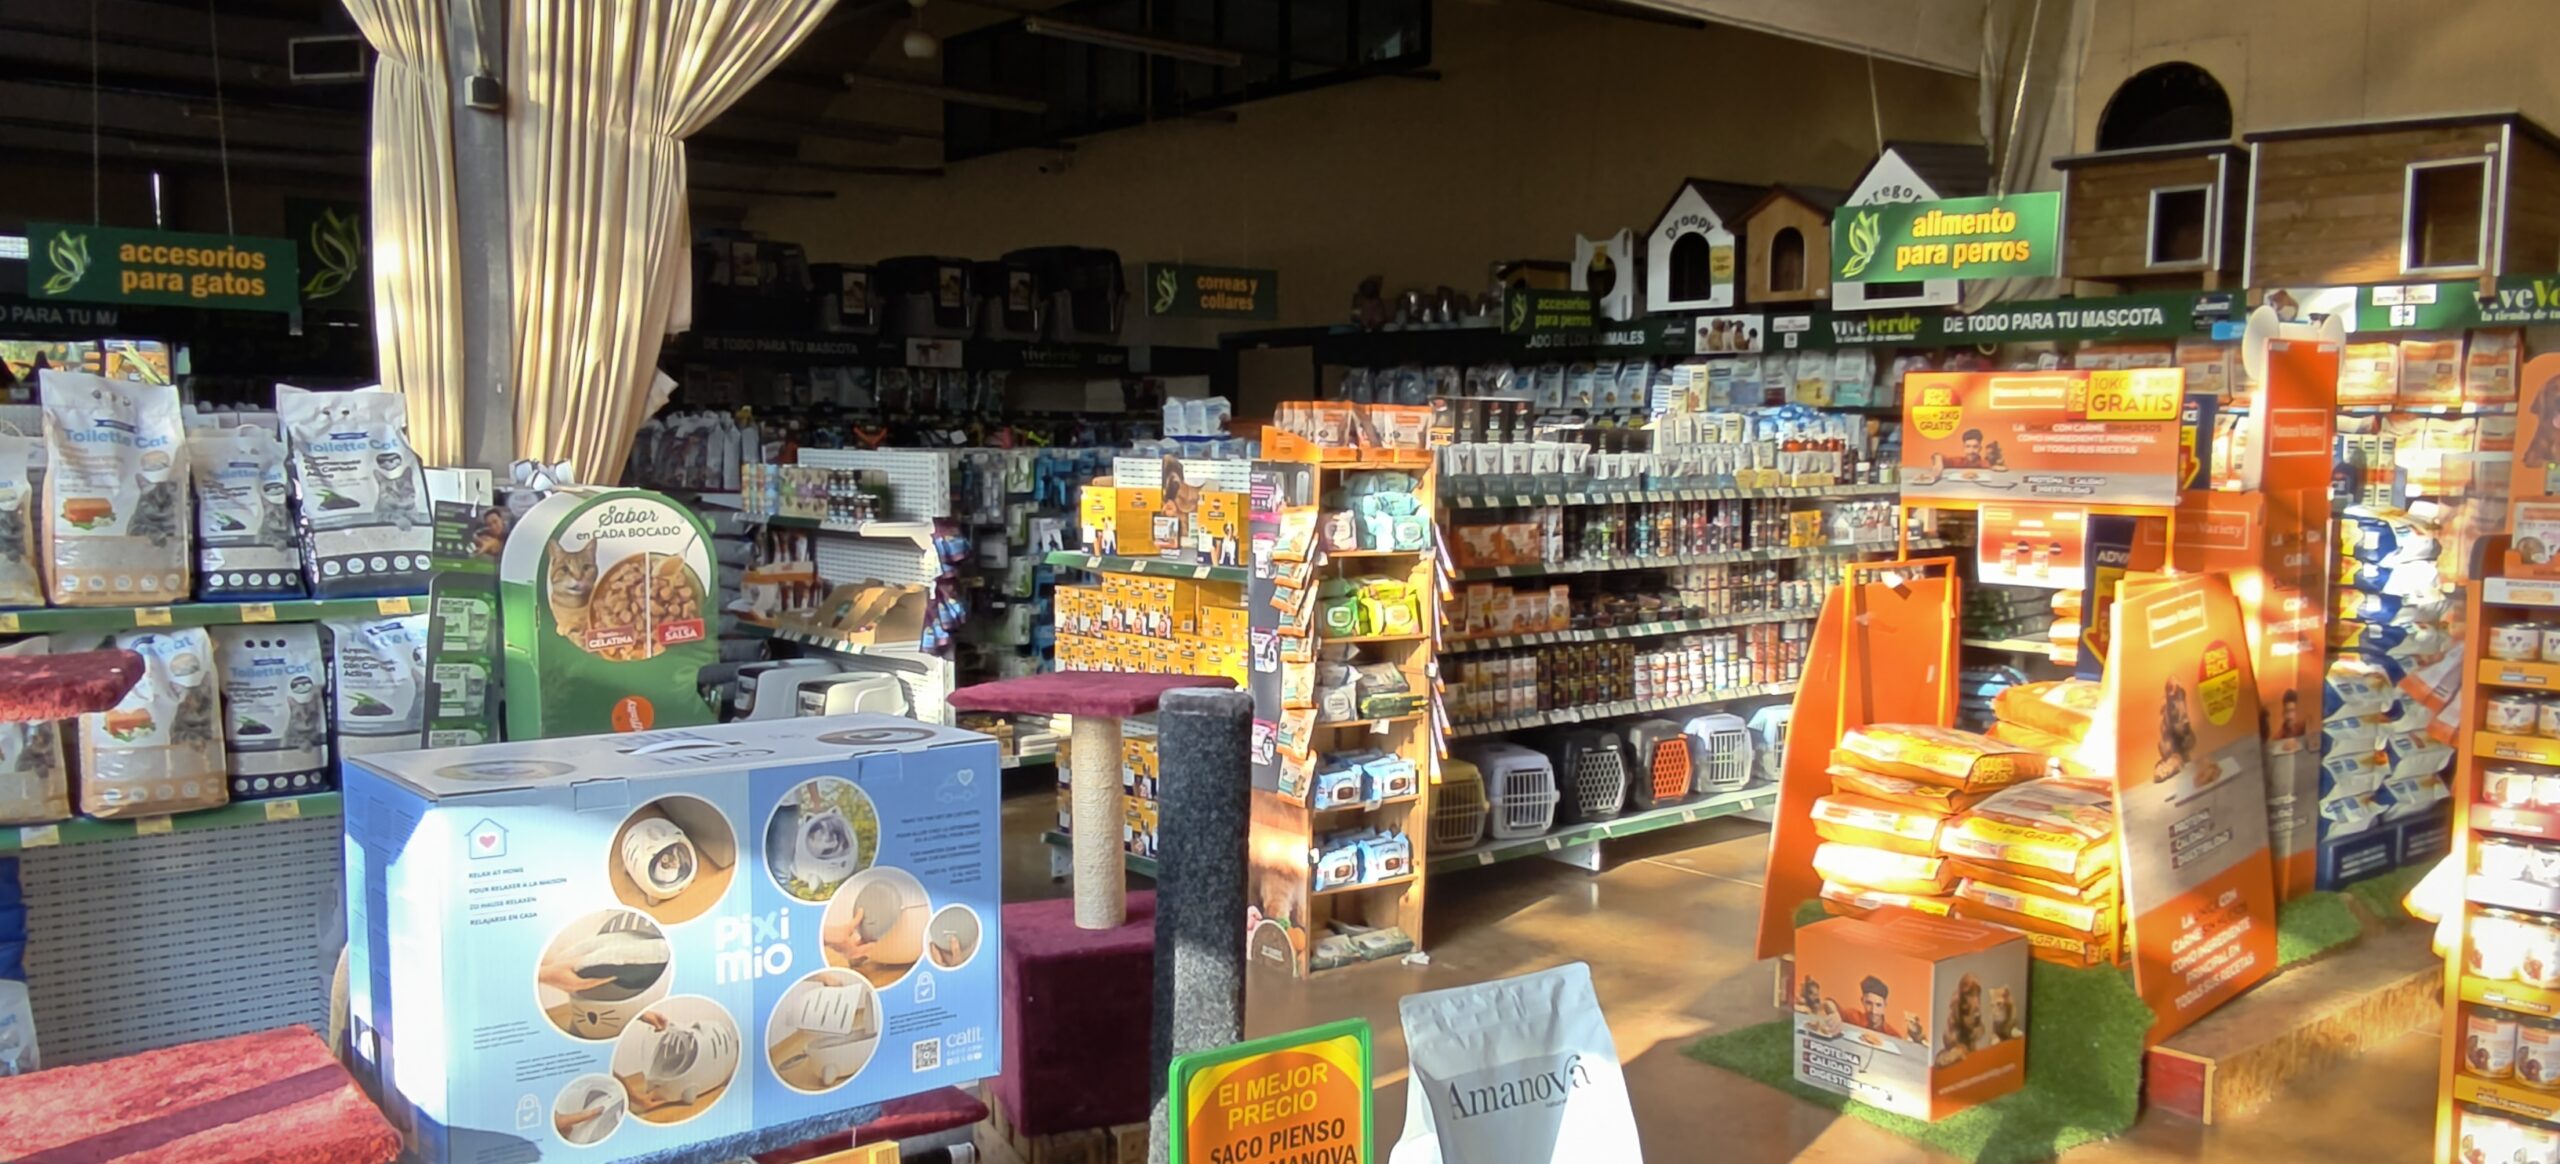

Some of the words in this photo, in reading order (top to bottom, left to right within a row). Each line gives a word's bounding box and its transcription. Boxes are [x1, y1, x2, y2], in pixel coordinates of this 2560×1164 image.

[1665, 215, 1715, 240] Droopy
[1912, 208, 2016, 237] alimento
[119, 243, 266, 270] accesorios
[1896, 244, 1949, 272] para
[1952, 240, 2030, 270] perros
[121, 270, 183, 294] para
[190, 273, 266, 299] gatos
[1196, 276, 1247, 292] correas
[1249, 278, 1258, 295] y
[1200, 293, 1255, 310] collares
[1537, 297, 1592, 310] accesorios
[12, 306, 63, 324] PARA
[67, 309, 90, 325] TU
[1535, 315, 1560, 328] para
[1562, 315, 1592, 329] perros
[1943, 316, 1964, 333] DE
[1968, 313, 2009, 332] TODO
[2012, 311, 2054, 330] PARA
[2057, 310, 2078, 328] TU
[2081, 307, 2164, 327] MASCOTA
[703, 338, 720, 350] DE
[722, 338, 754, 352] TODO
[756, 339, 787, 352] PARA
[789, 340, 805, 353] TU
[806, 341, 859, 356] MASCOTA
[1591, 330, 1645, 346] ANIMALES
[2091, 393, 2174, 412] GRATIS
[134, 435, 168, 449] Cat
[303, 441, 367, 453] Toilette
[368, 439, 398, 450] Cat
[599, 505, 660, 527] Sabor
[576, 532, 590, 540] en
[592, 528, 626, 540] CADA
[628, 525, 681, 538] BOCADO
[664, 629, 698, 641] SALSA
[946, 1026, 981, 1048] catit
[1809, 1054, 1852, 1076] CALIDAD
[1246, 1062, 1329, 1101] MEJOR
[1228, 1090, 1318, 1131] PRECIO
[1210, 1136, 1264, 1164] SACO
[1269, 1117, 1346, 1154] PIENSO
